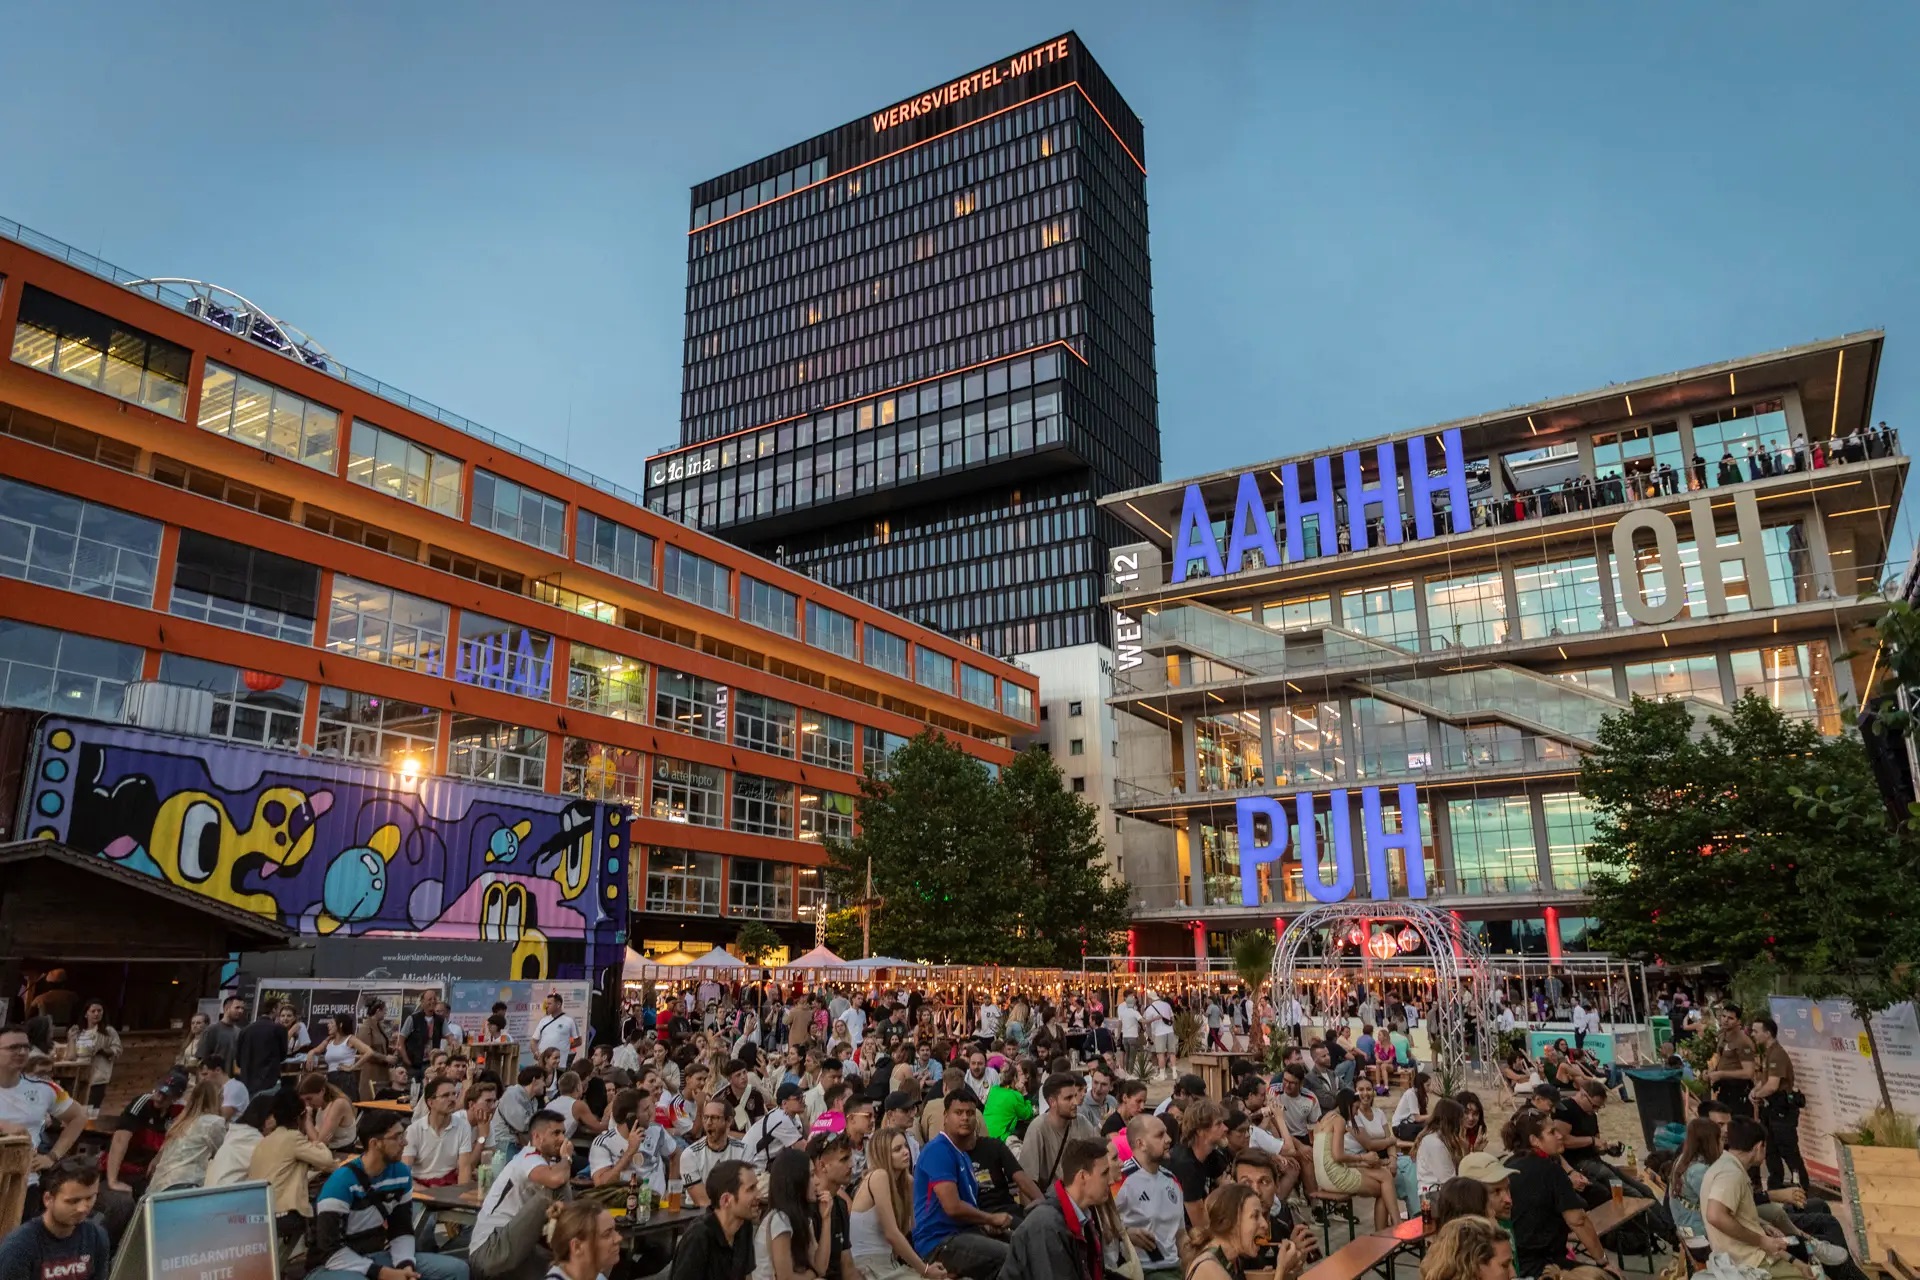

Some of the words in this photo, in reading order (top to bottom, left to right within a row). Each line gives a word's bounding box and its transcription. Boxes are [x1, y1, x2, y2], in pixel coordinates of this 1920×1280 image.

[873, 37, 1068, 132] WERKSVIERTEL-MITTE
[1171, 428, 1472, 583] AAHHH
[1612, 490, 1774, 625] OH
[671, 770, 713, 787] attempto
[1236, 783, 1428, 908] PUH
[312, 1004, 330, 1015] DEEP
[330, 1003, 355, 1015] PURPLE
[161, 1242, 268, 1271] BIERGARNITUREN
[201, 1266, 234, 1280] BITTE
